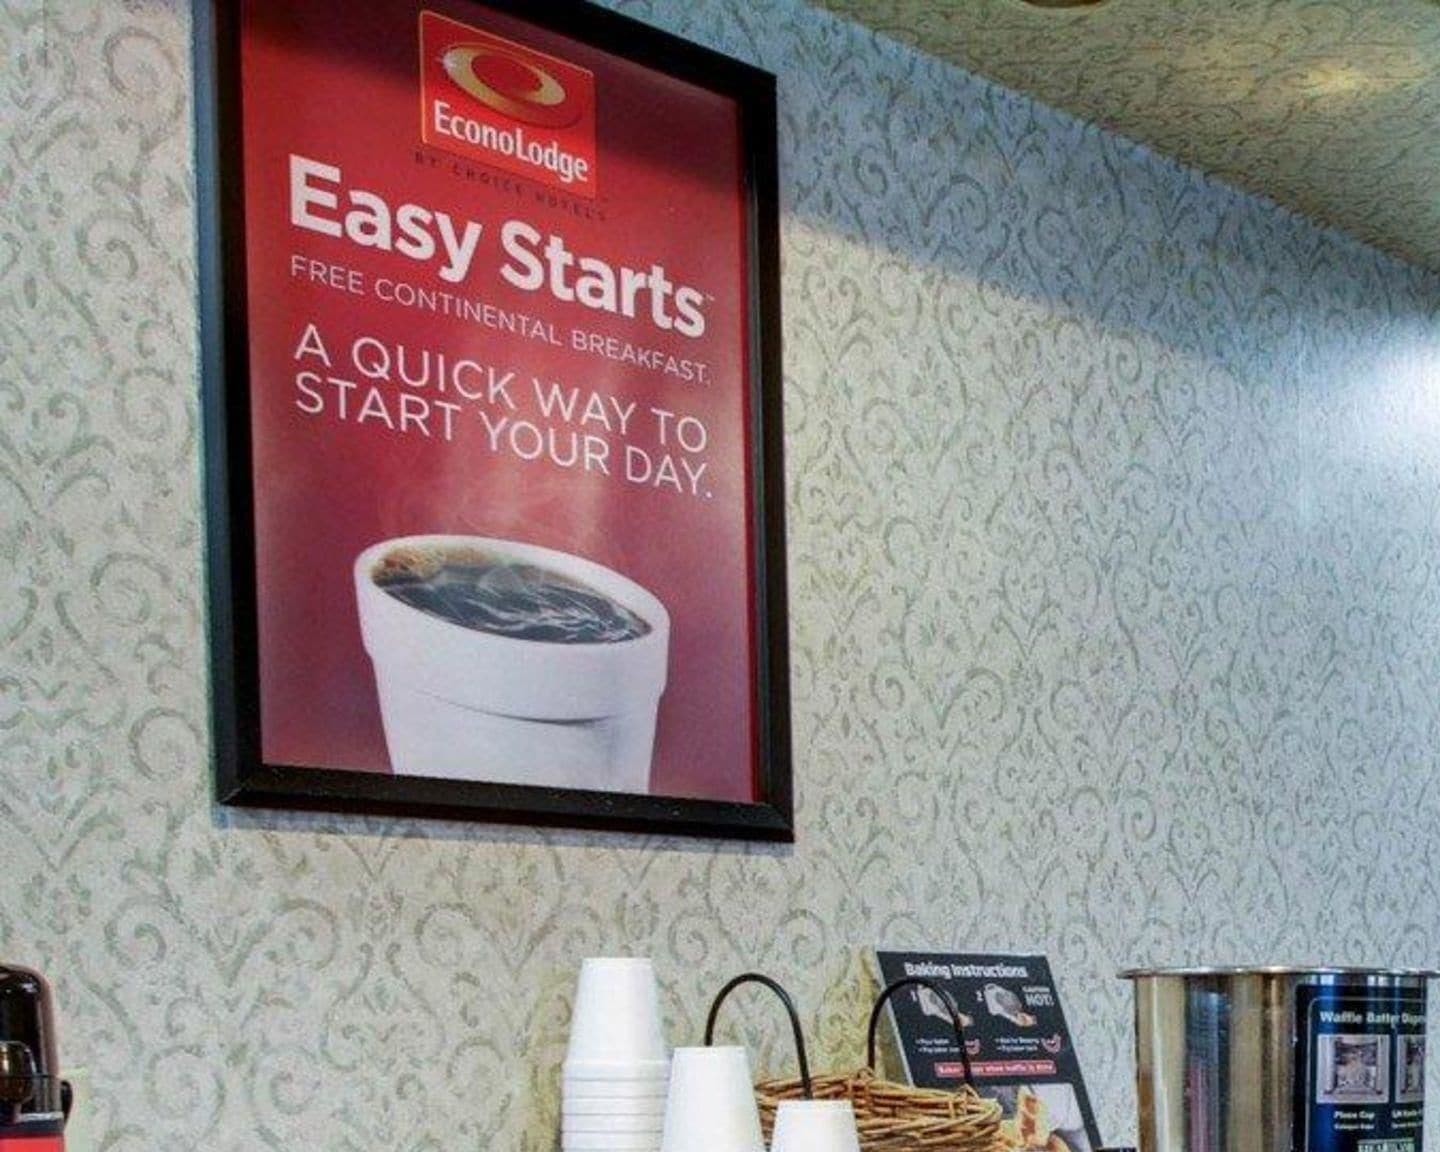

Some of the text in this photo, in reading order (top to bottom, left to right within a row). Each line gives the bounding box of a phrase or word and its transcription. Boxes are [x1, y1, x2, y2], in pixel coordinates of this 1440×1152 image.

[434, 101, 588, 183] EconoLodge
[289, 154, 482, 284] Easy
[291, 255, 364, 295] FREE
[376, 277, 562, 347] CONTINENTAL
[295, 324, 707, 454] A QUICK WAY TO
[296, 373, 713, 499] START YOUR DAY.
[904, 962, 951, 979] Baking
